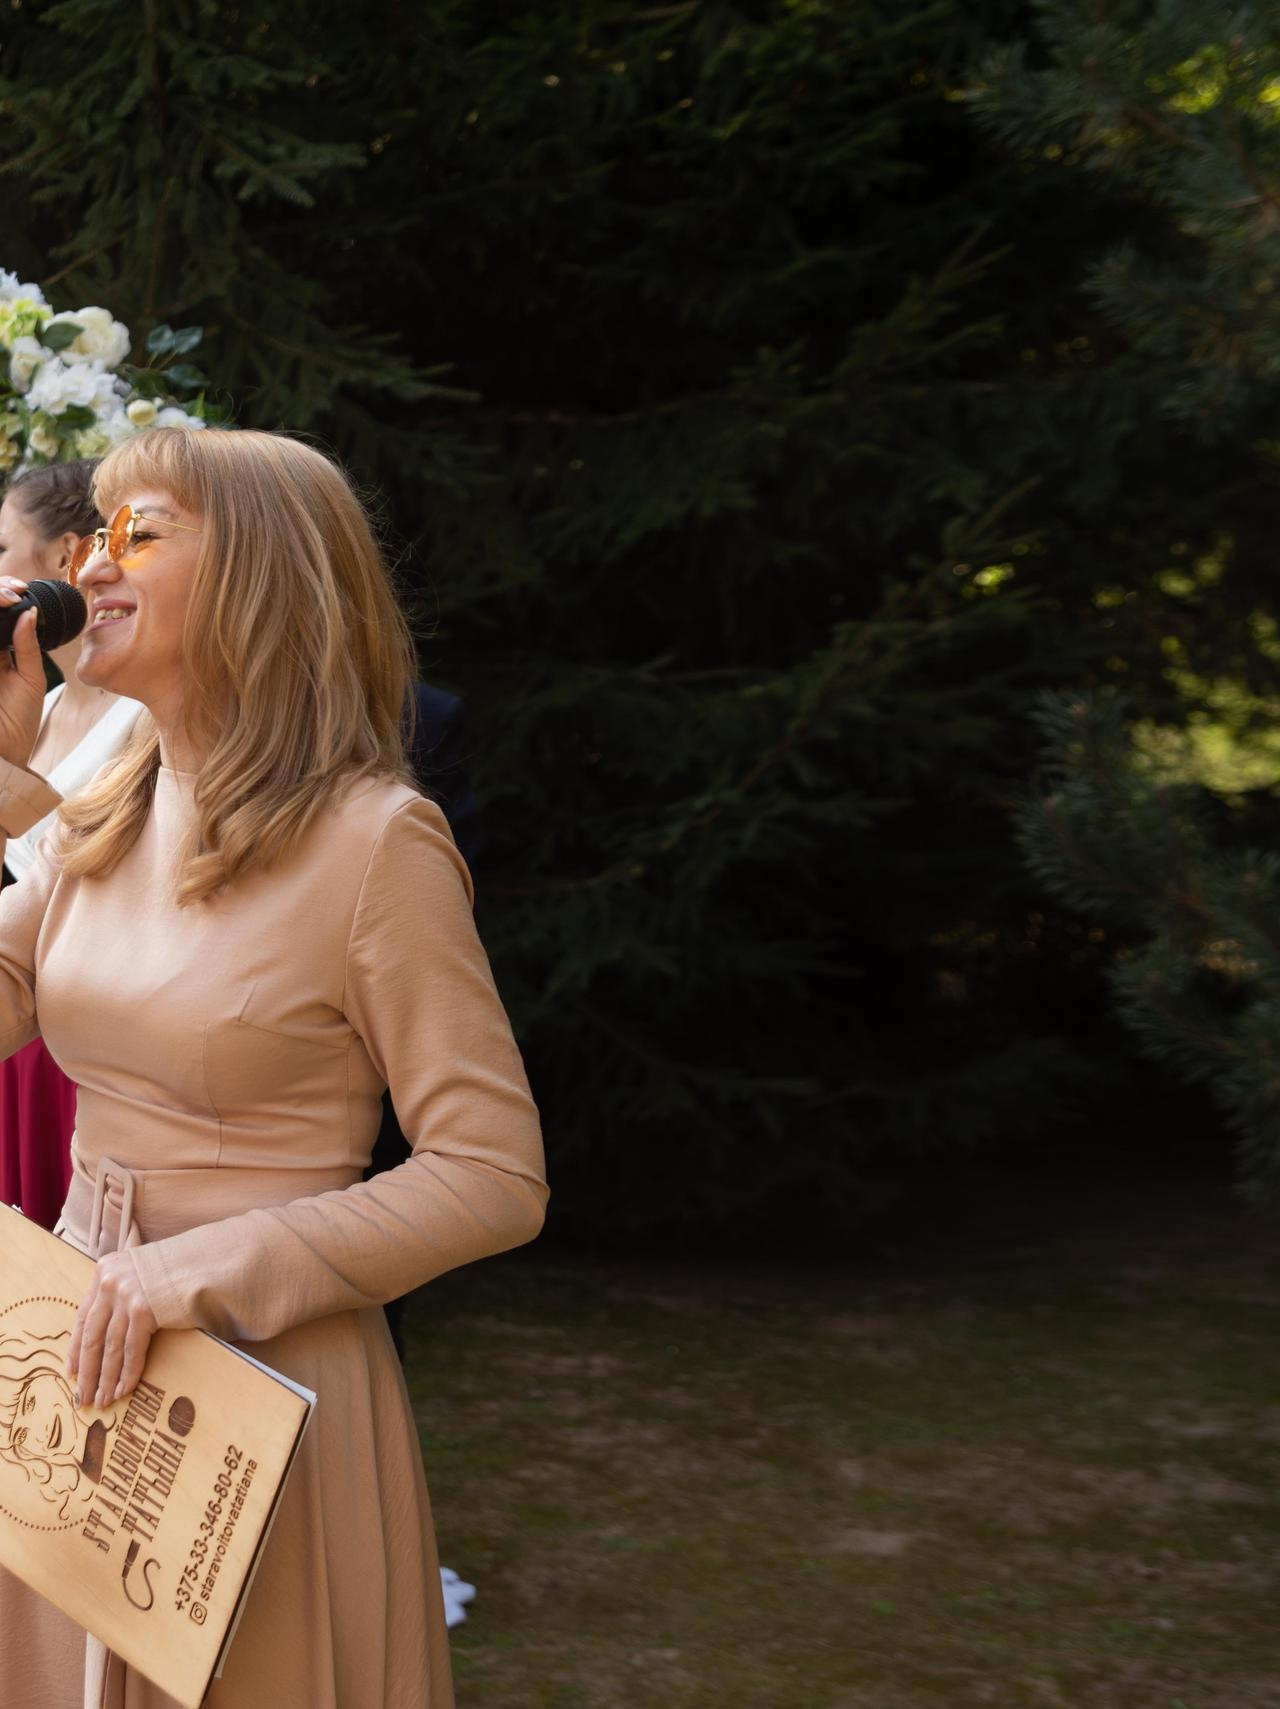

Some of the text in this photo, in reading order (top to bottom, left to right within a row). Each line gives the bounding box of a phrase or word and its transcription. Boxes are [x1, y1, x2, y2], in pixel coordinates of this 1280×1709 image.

[121, 1429, 187, 1542] ТАТЬЯНА
[175, 1444, 244, 1612] +375-33-346-80-62
[200, 1459, 259, 1601] staravoitovatatiana
